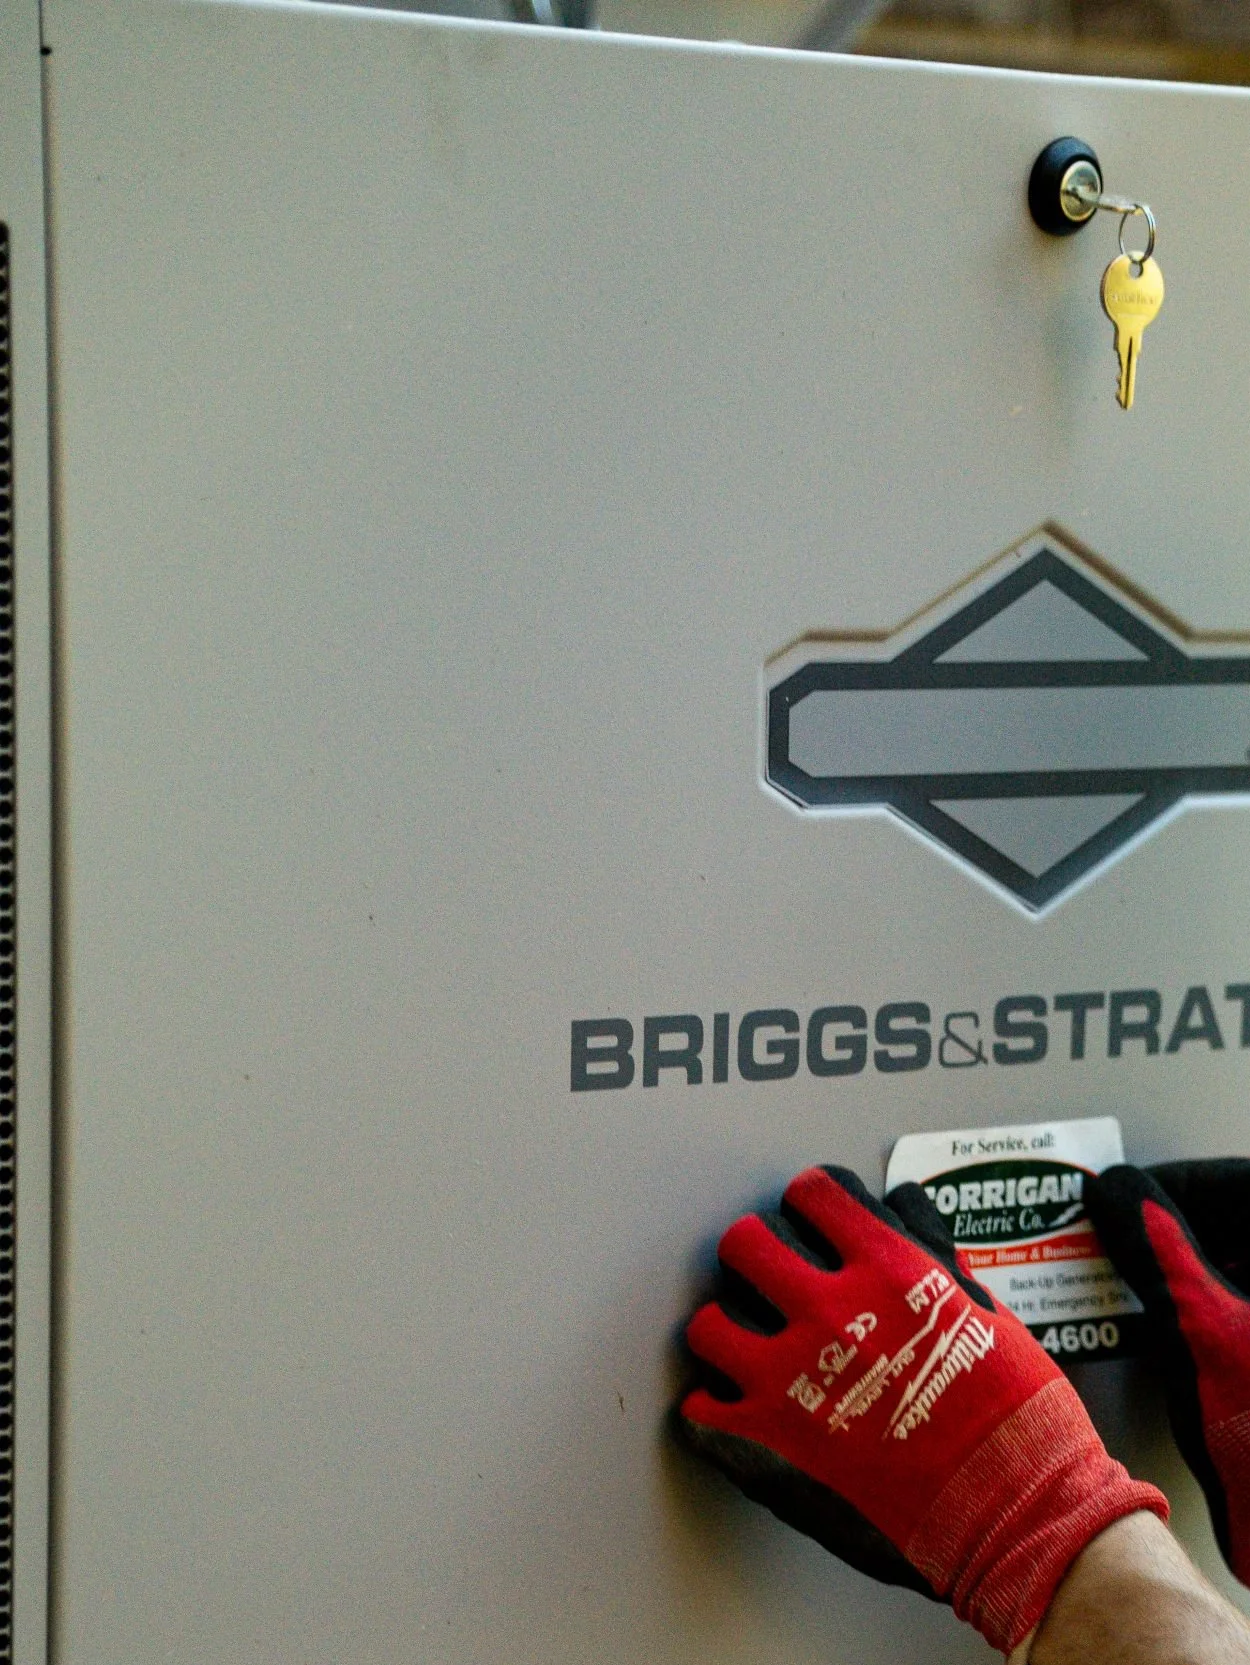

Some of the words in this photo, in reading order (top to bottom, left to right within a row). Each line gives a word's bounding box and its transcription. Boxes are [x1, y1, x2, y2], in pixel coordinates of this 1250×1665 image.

[951, 1140, 973, 1156] For
[976, 1135, 1028, 1155] Service,
[1031, 1132, 1056, 1149] call:
[953, 1210, 1014, 1237] Electric
[1018, 1207, 1046, 1229] Co.
[1029, 1246, 1041, 1261] &
[1040, 1293, 1105, 1311] Emergency
[893, 1316, 994, 1440] Milwaukee
